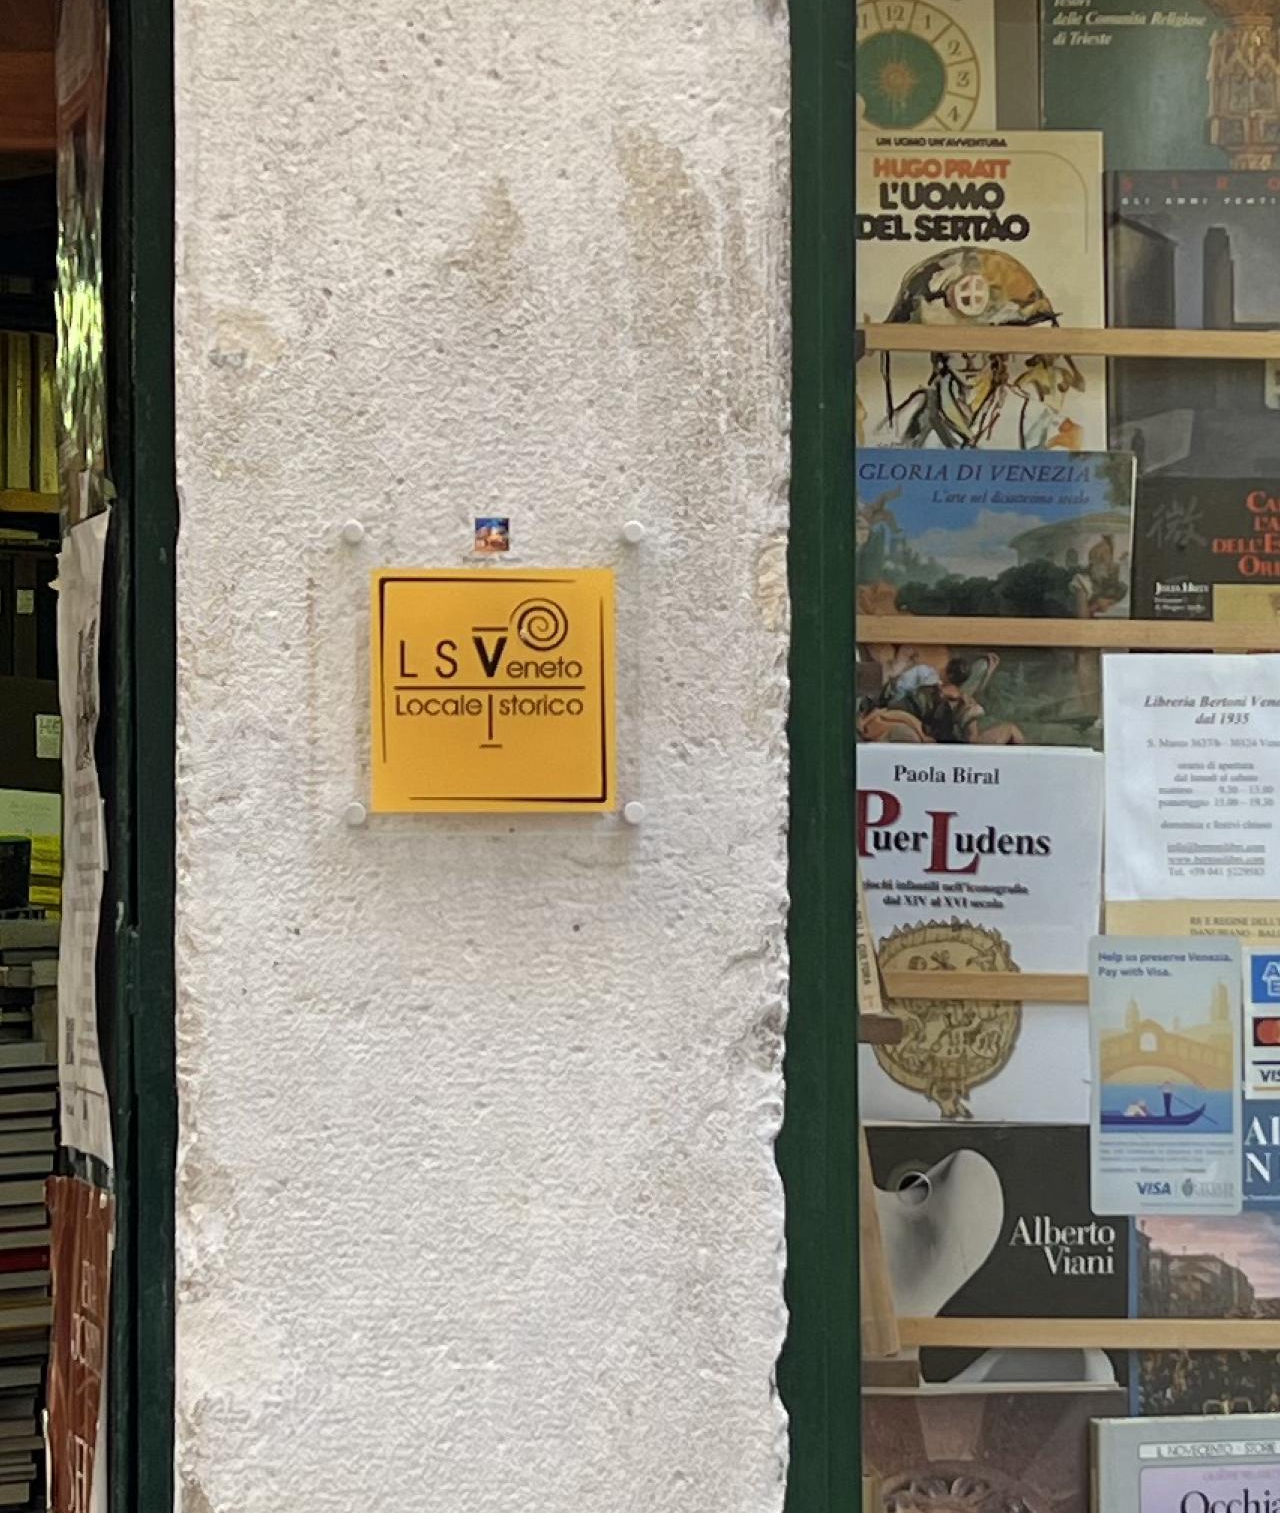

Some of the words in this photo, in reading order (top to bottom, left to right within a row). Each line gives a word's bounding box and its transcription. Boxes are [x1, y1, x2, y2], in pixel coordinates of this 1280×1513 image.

[1052, 11, 1083, 27] delle
[1052, 31, 1066, 47] di
[1069, 31, 1113, 47] Trieste
[873, 158, 942, 179] HUGO
[944, 159, 1012, 180] PRATT
[879, 182, 1006, 211] L'UOMO
[856, 214, 911, 241] DEL
[859, 463, 949, 483] GLORIA
[957, 463, 987, 483] DI
[990, 464, 1091, 484] VENEZIA
[399, 639, 418, 678] L
[435, 638, 459, 679] S
[472, 635, 584, 679] Veneto
[395, 693, 483, 718] Locale
[498, 693, 584, 718] storico
[1143, 695, 1196, 709] Libreria
[1199, 695, 1248, 709] Bertoni
[1194, 713, 1216, 726] dal
[1219, 713, 1251, 726] 1935
[894, 765, 946, 784] Paola
[952, 766, 1000, 786] Biral
[856, 789, 929, 859] Puer
[923, 809, 1053, 875] Ludens
[882, 895, 901, 907] dal
[930, 896, 941, 908] al
[1098, 951, 1123, 965] Help
[1125, 952, 1138, 964] us
[1139, 952, 1187, 965] preserve
[1097, 966, 1118, 979] Pay
[1119, 966, 1145, 978] with
[1146, 966, 1173, 978] Visa.
[1136, 1182, 1172, 1197] VISA
[1008, 1216, 1116, 1248] Alberto
[1044, 1246, 1115, 1276] Viani
